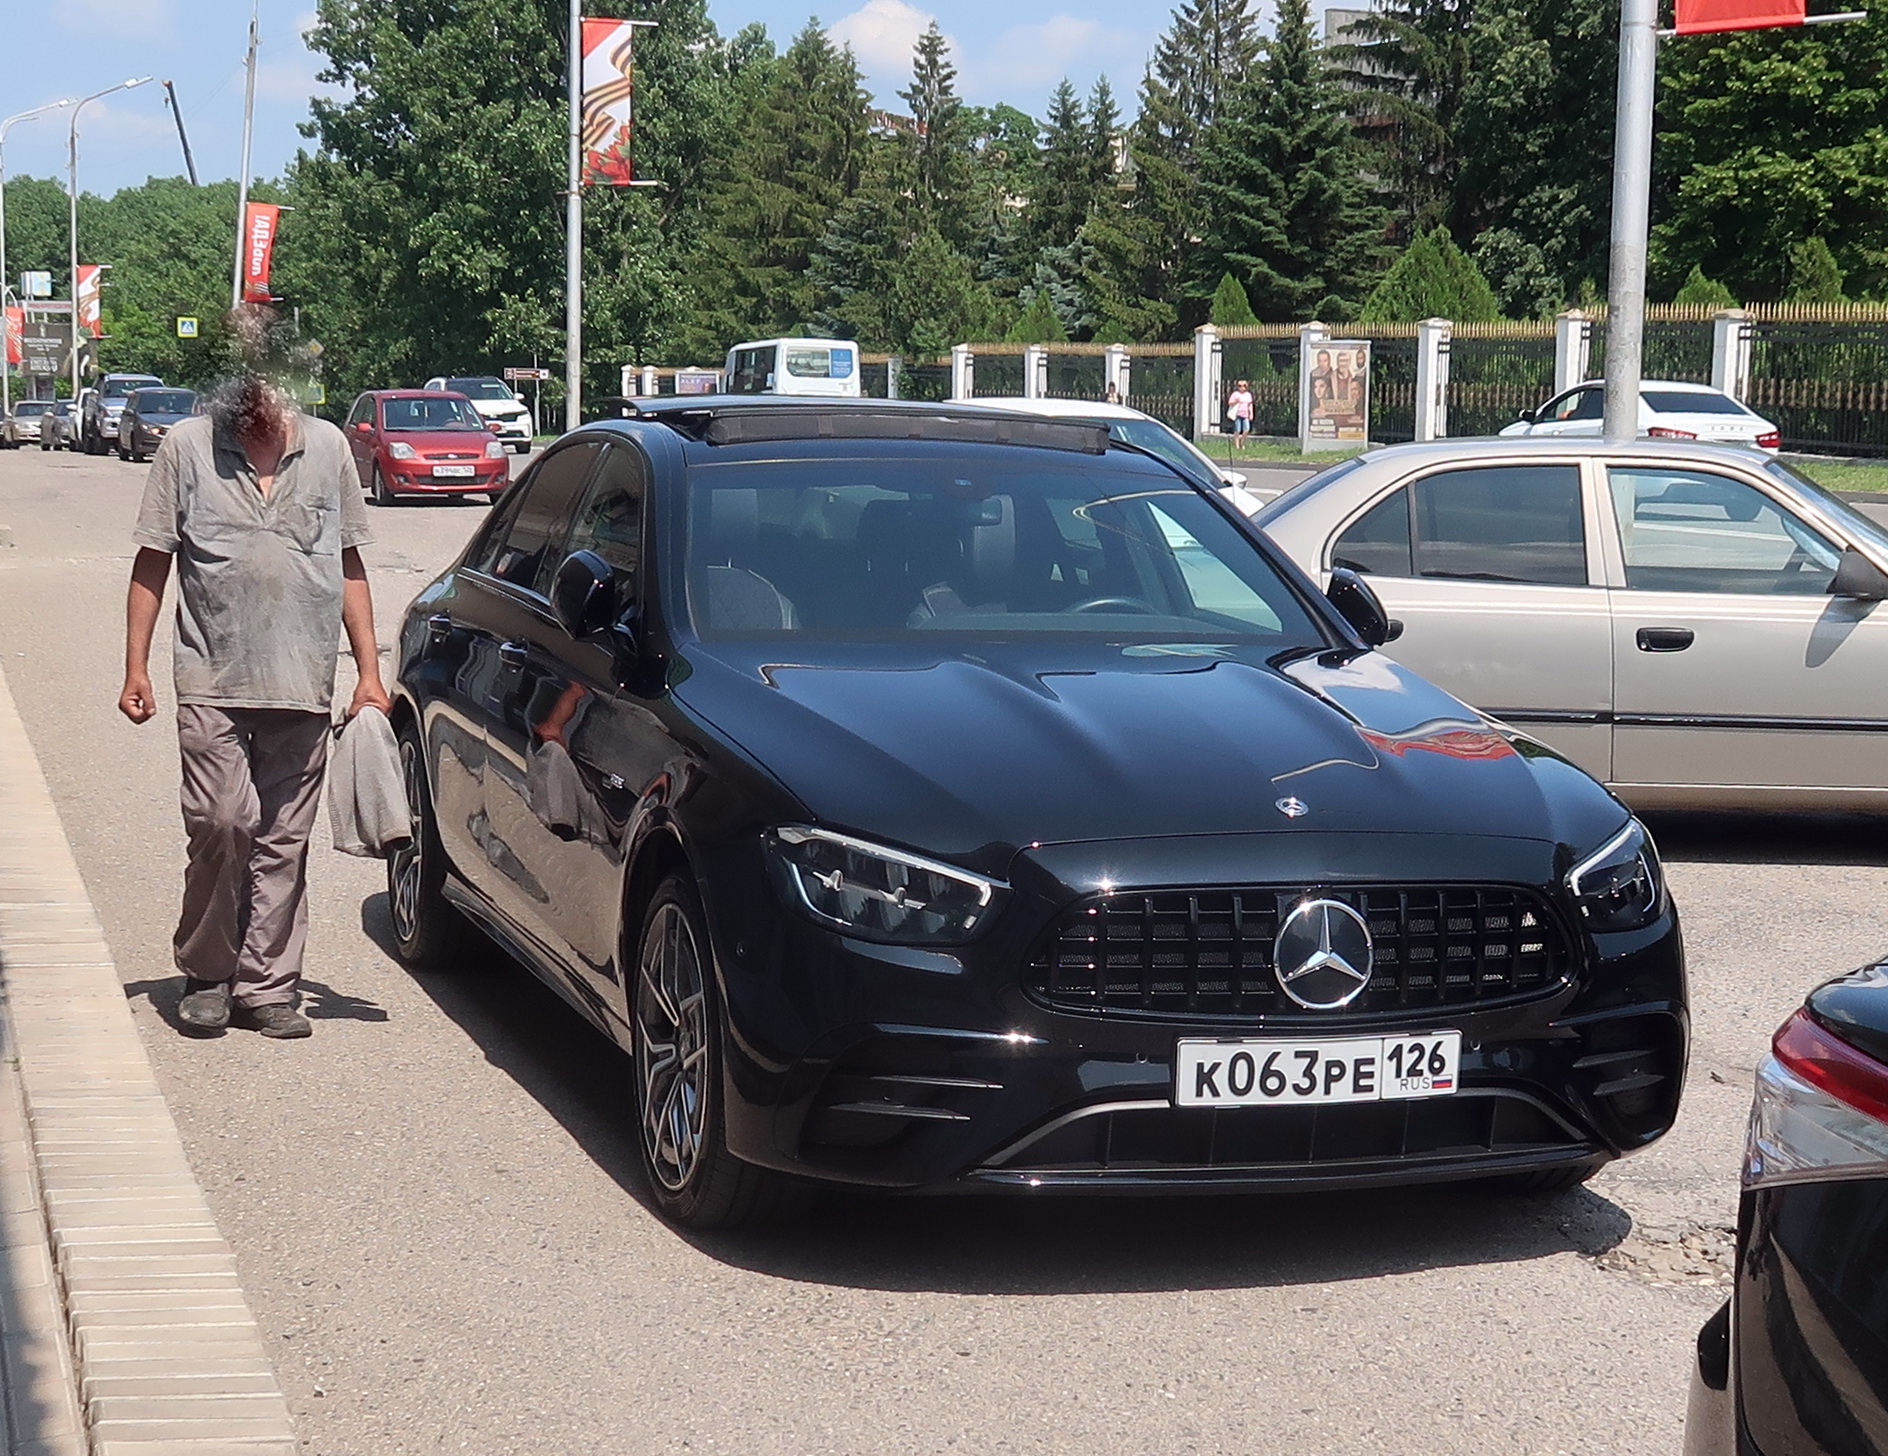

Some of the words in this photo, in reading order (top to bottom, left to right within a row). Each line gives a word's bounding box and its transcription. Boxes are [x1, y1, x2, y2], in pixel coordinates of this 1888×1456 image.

[1195, 1050, 1376, 1098] К063РЕ
[1387, 1040, 1445, 1079] 126
[1399, 1076, 1430, 1092] RUS
